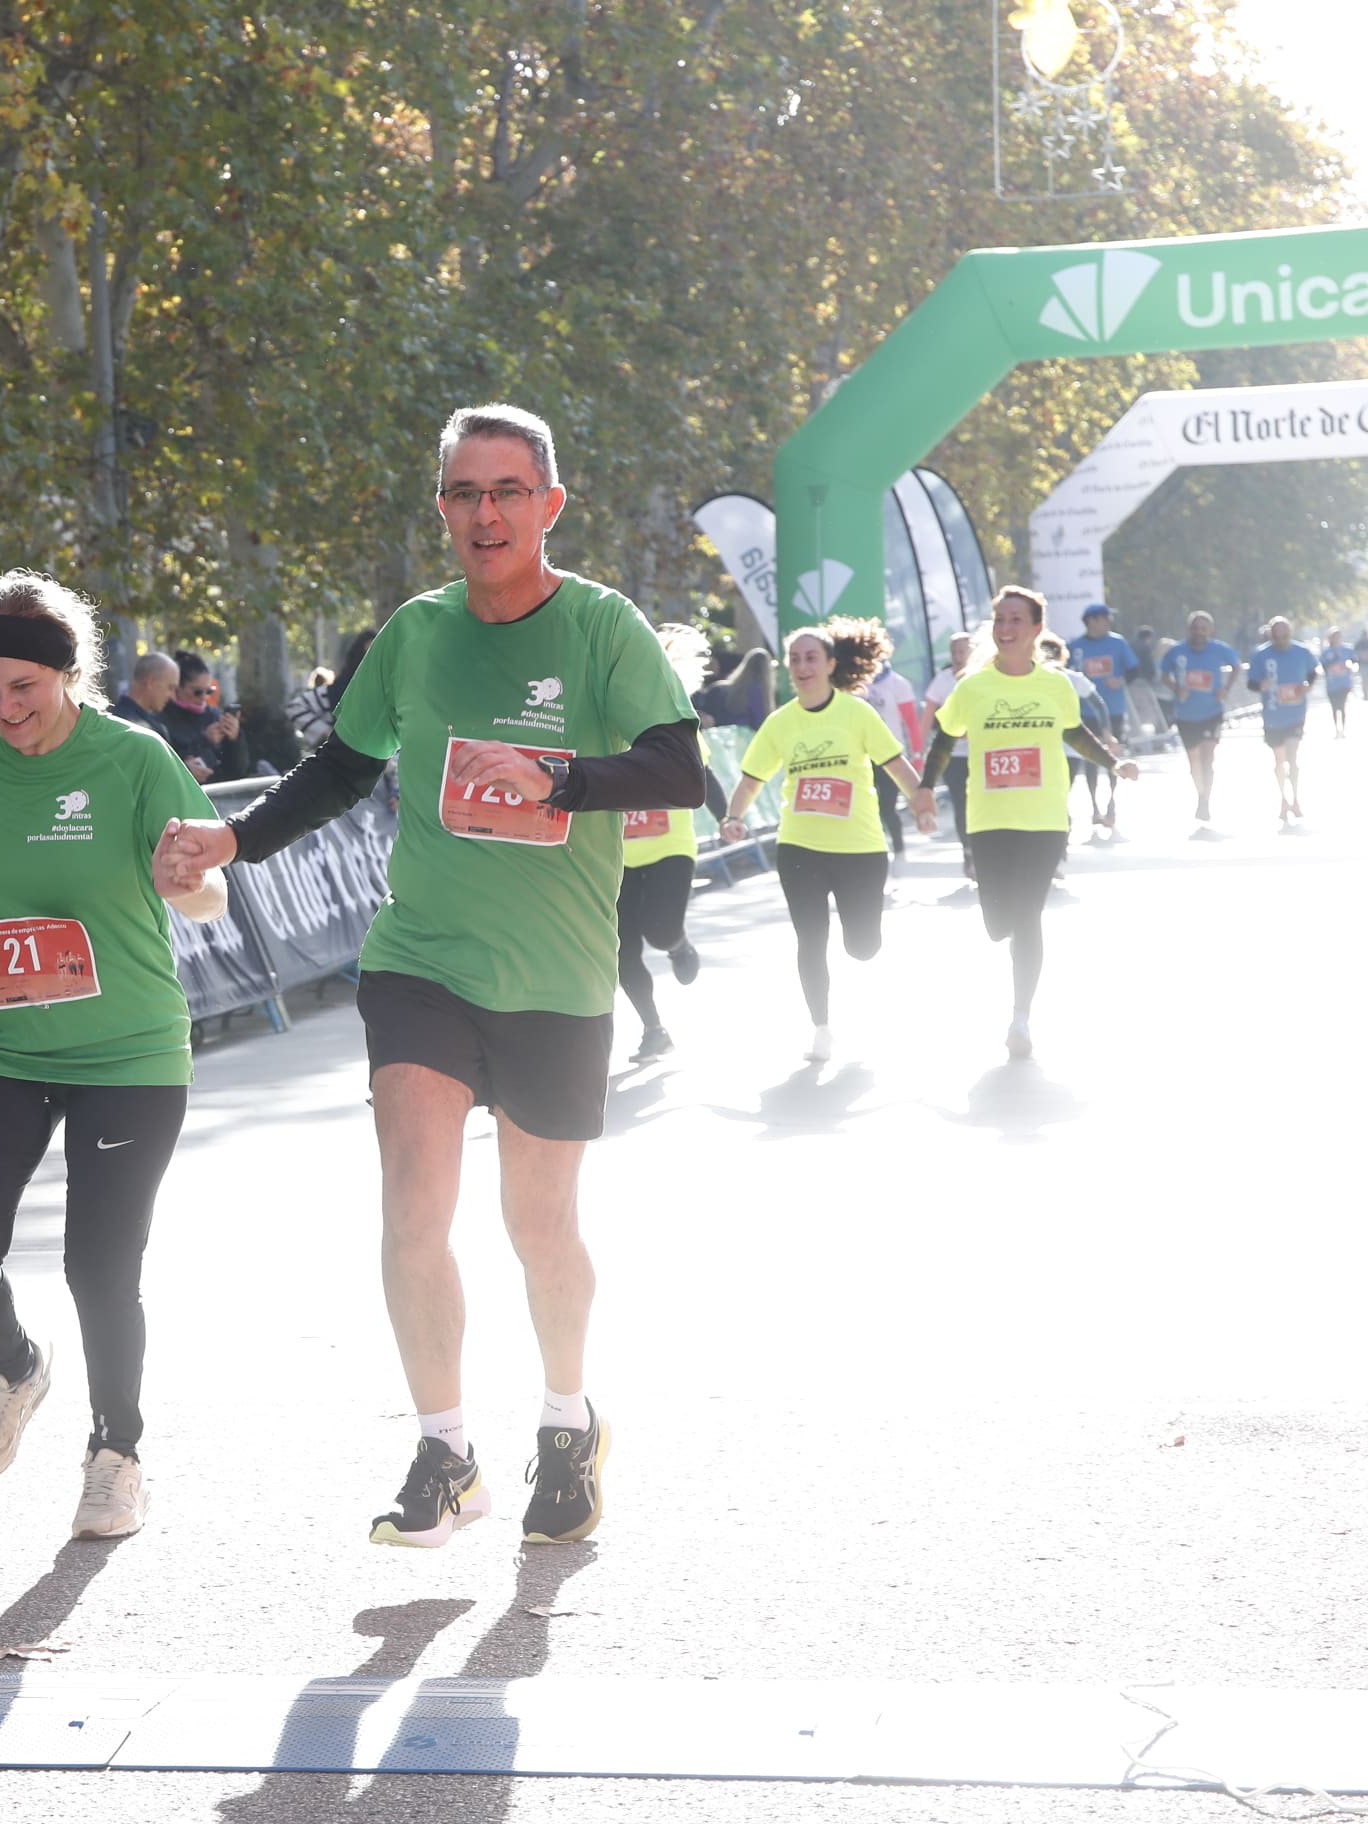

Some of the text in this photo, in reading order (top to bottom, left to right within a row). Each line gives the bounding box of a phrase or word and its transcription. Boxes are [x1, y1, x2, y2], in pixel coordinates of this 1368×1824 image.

[1182, 410, 1221, 445] El
[1230, 409, 1311, 442] Norte
[1318, 406, 1350, 436] de
[543, 701, 564, 710] intras
[521, 710, 565, 724] #doylacara
[493, 717, 565, 734] porlasaludmental
[984, 720, 1055, 730] MICHELIN
[789, 759, 848, 774] MICHELIN
[990, 755, 1020, 776] 523
[801, 783, 831, 801] 525
[52, 824, 93, 833] #doylacara
[27, 832, 93, 844] porlasaludmental
